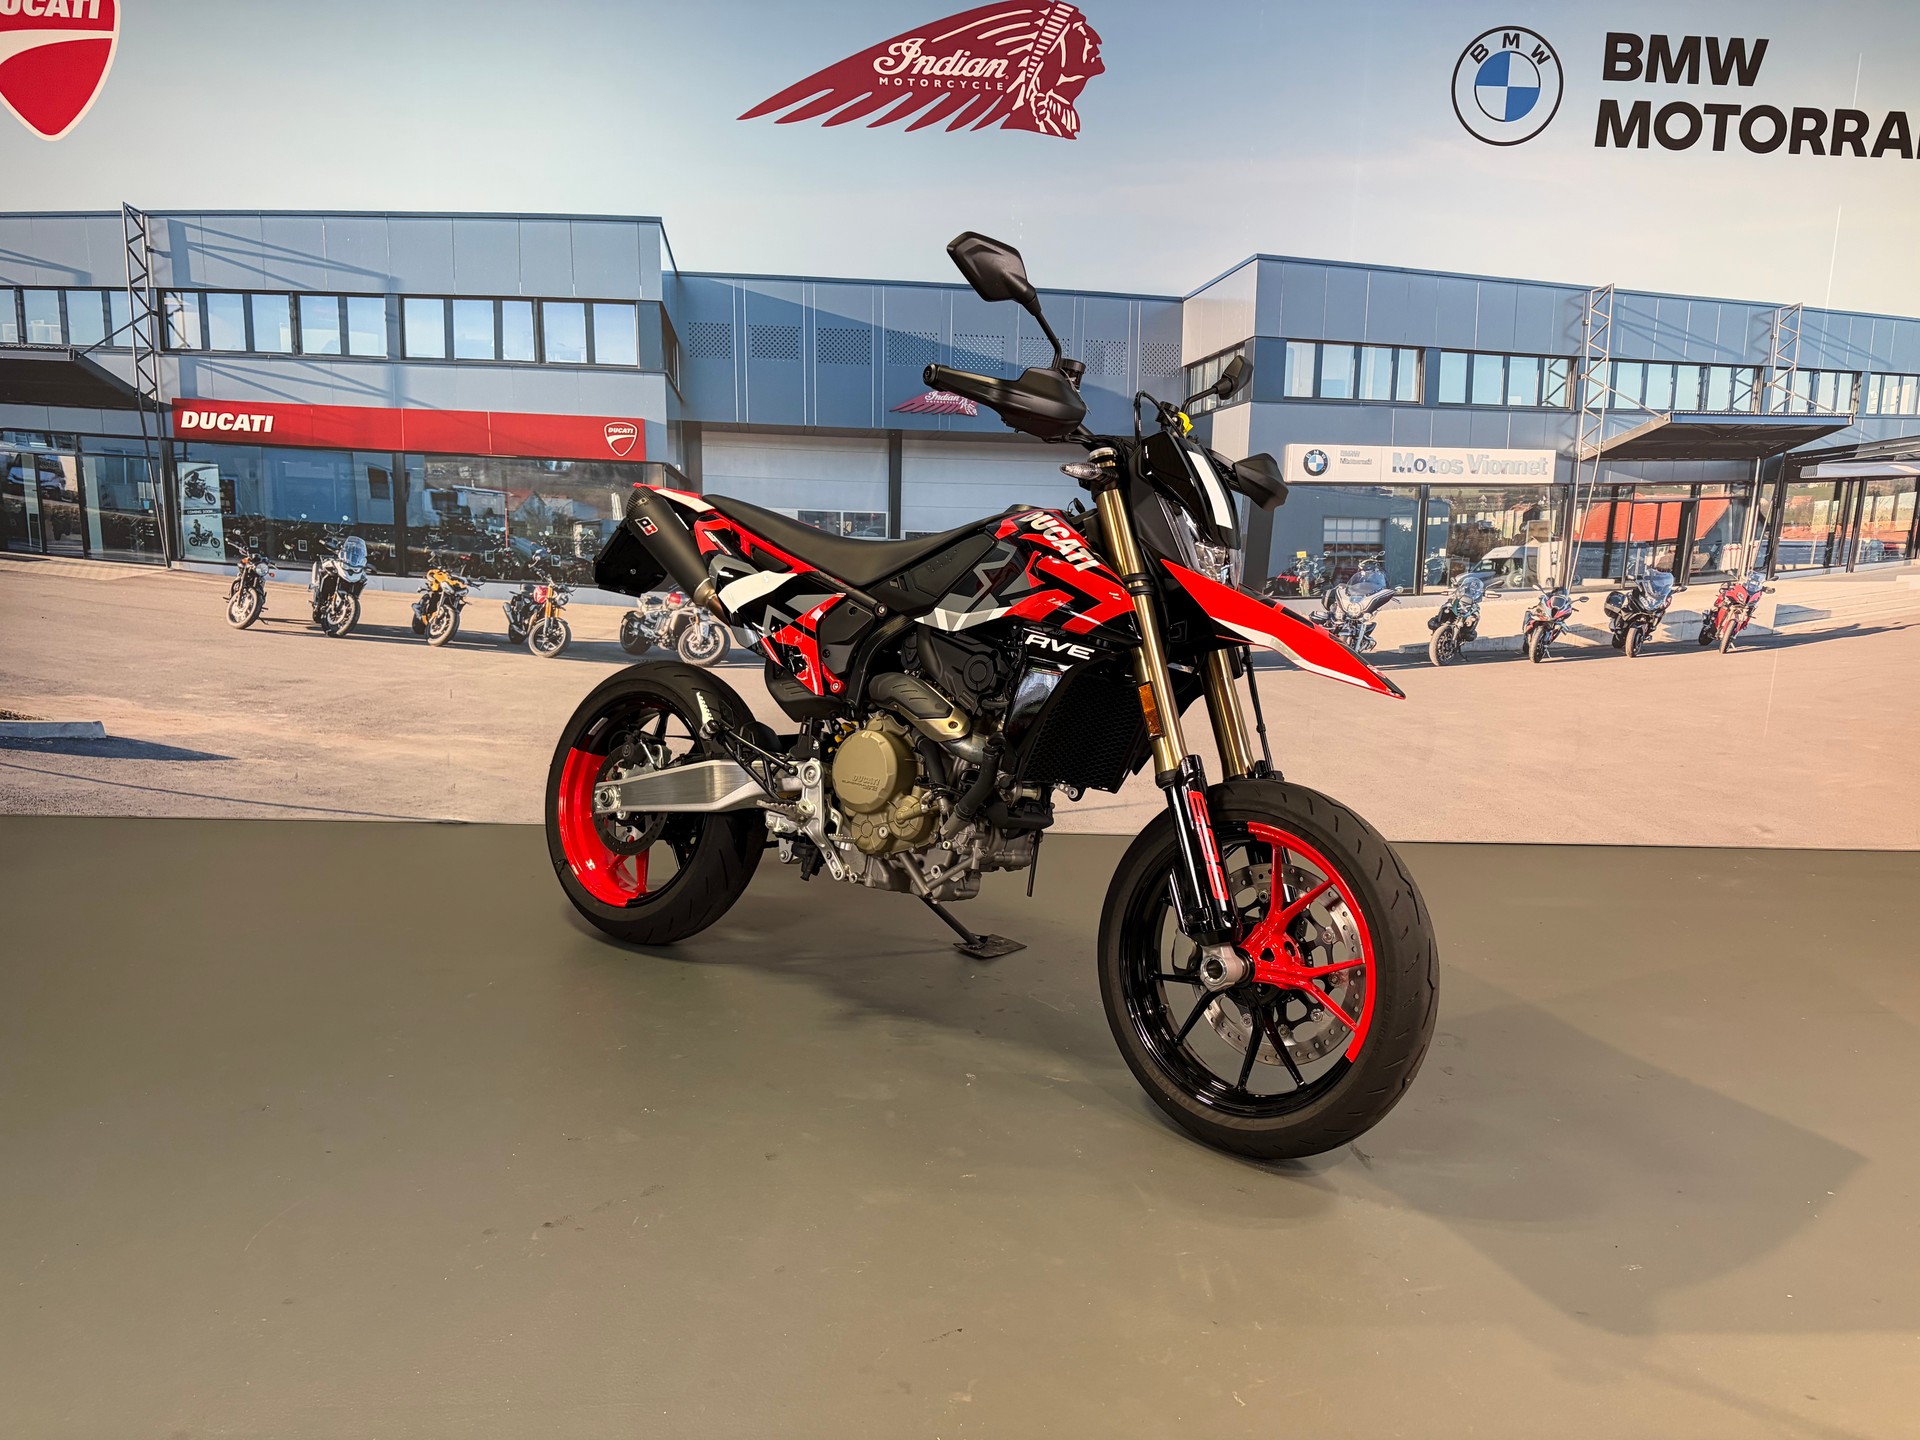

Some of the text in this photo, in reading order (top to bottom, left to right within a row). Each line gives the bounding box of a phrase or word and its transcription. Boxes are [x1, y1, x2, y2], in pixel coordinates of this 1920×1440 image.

[0, 0, 100, 19] UCATI
[873, 38, 1009, 79] Indian
[1470, 33, 1551, 65] BMW
[1603, 32, 1769, 87] BMW
[879, 77, 1003, 91] MOTORCYCLE
[1594, 99, 1920, 160] MOTORRA
[925, 391, 959, 402] Indian
[181, 411, 274, 433] DUCATI
[1392, 452, 1548, 475] Motos Vionnet
[1019, 511, 1101, 572] DUCATI
[852, 775, 881, 786] DUCATI
